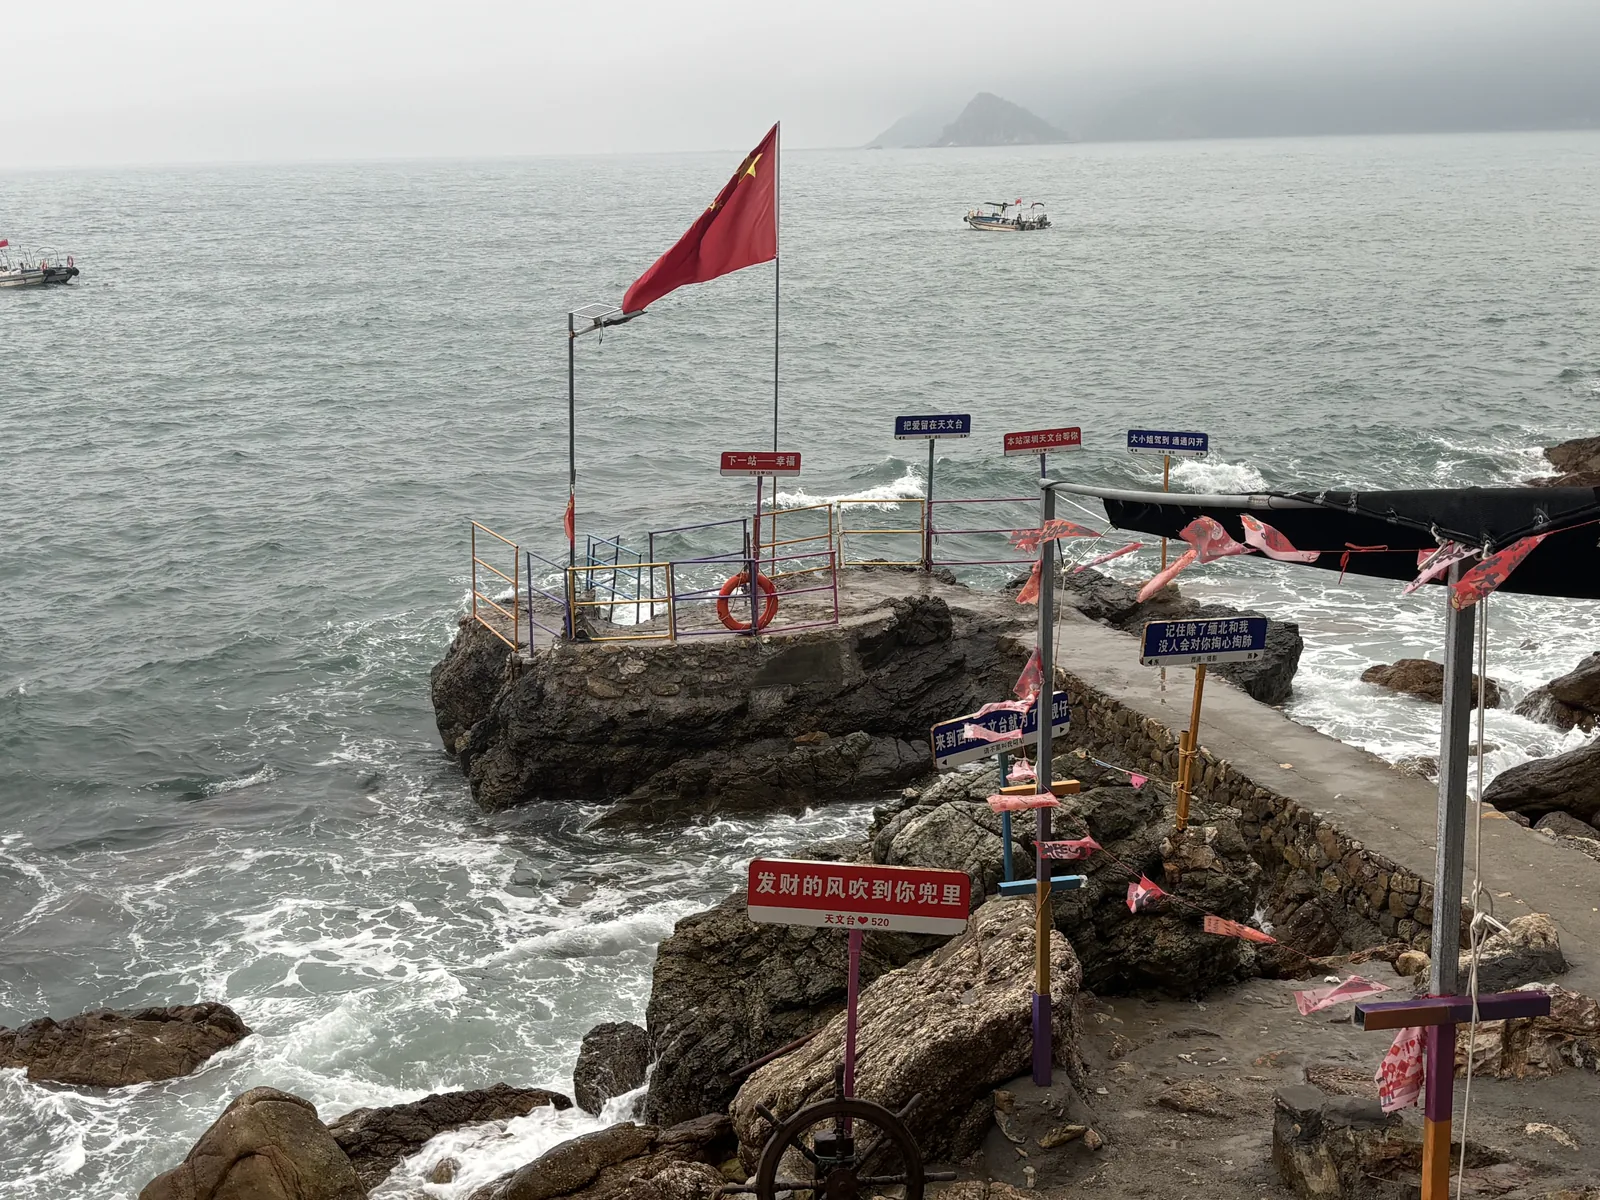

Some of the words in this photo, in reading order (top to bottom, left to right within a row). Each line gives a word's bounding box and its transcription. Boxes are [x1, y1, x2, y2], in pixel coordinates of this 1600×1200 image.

[903, 419, 963, 431] 把爱留在天文台
[1165, 620, 1249, 638] 记住除了缅北和我
[1158, 635, 1253, 653] 没人会对你掏心掏肺
[755, 872, 962, 906] 发财的风吹到你兜里
[824, 913, 856, 926] 天文台
[871, 917, 890, 927] 520
